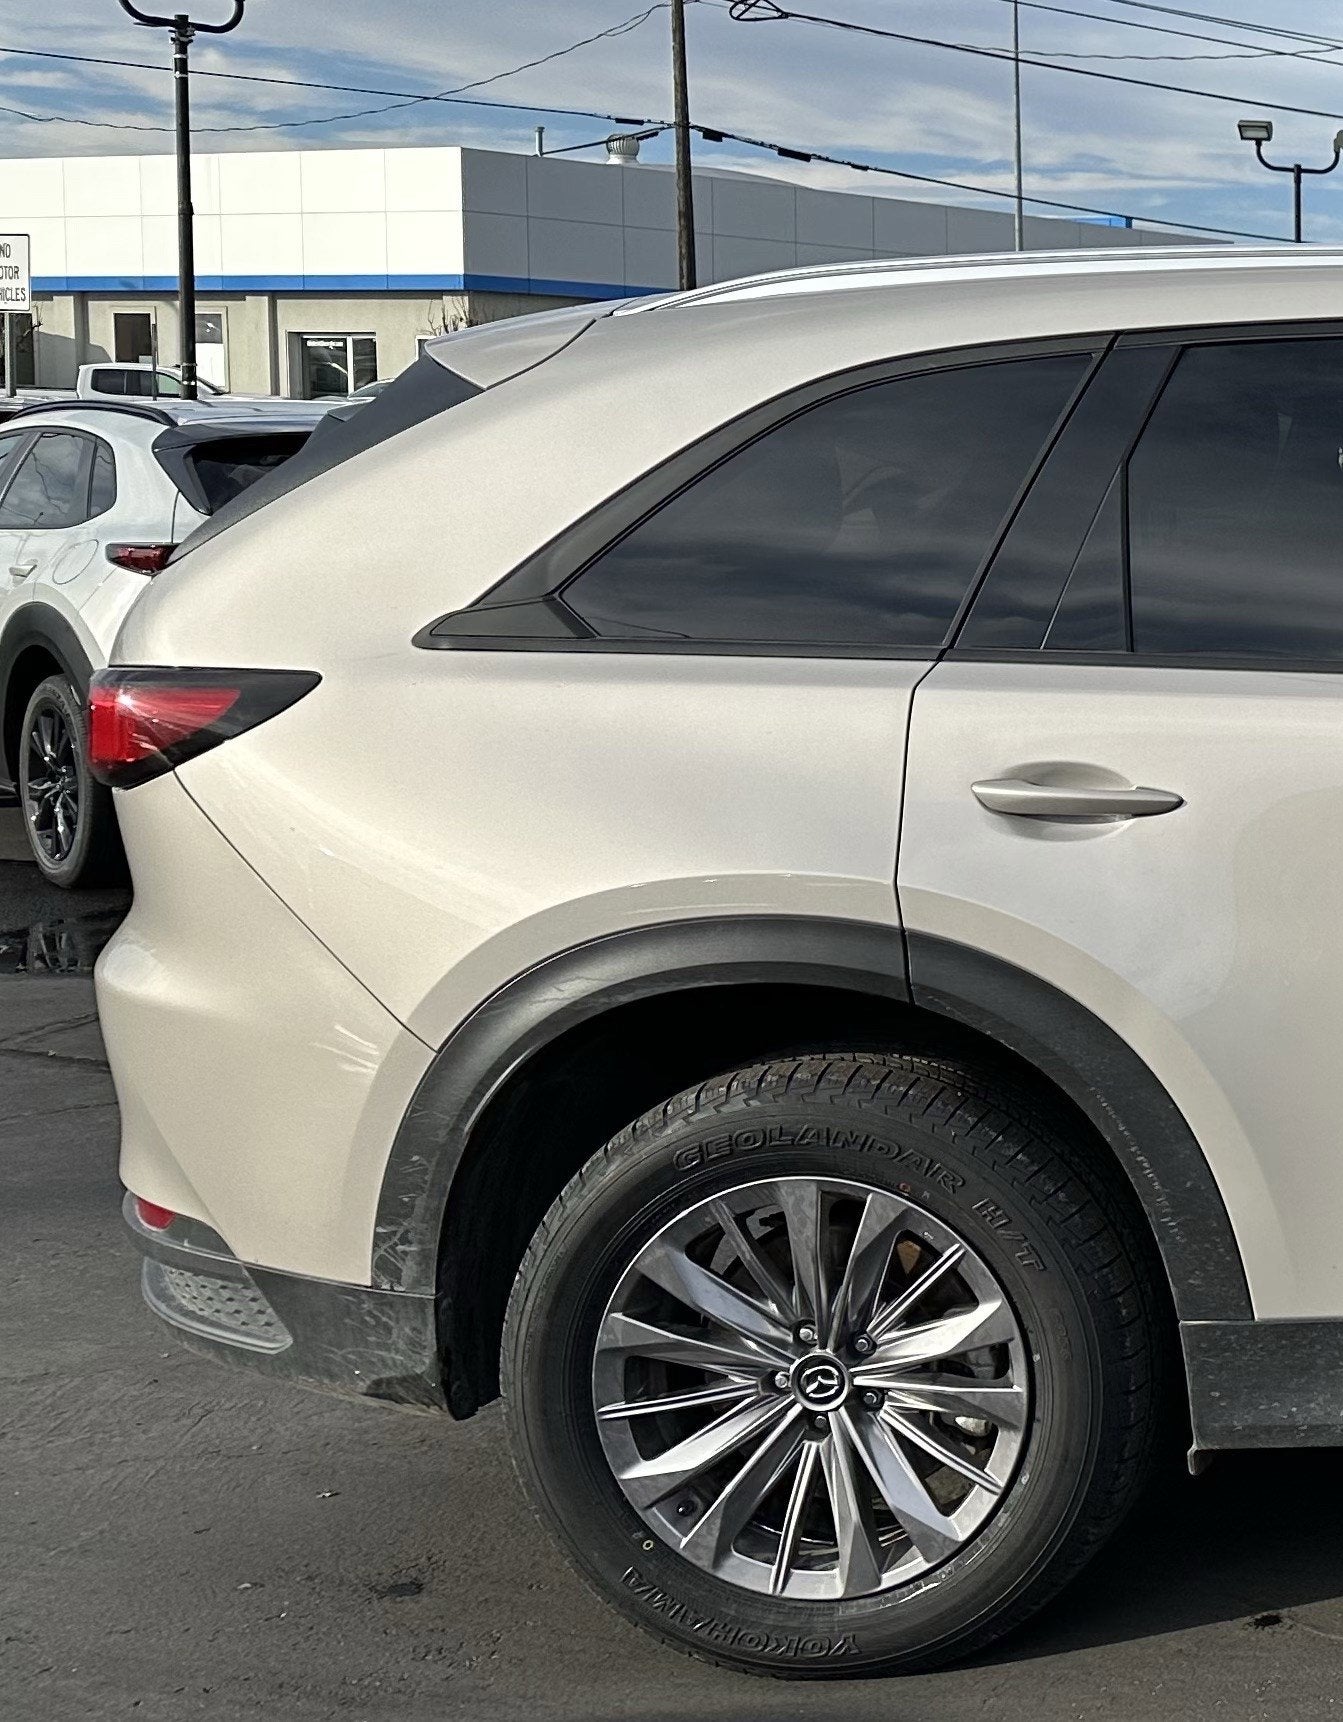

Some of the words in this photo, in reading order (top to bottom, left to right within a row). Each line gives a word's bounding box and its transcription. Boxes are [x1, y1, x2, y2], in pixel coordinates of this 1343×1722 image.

[0, 265, 20, 280] OTOR
[672, 1124, 967, 1196] GEOLANDAR
[619, 1565, 863, 1658] YOKOHAMA
